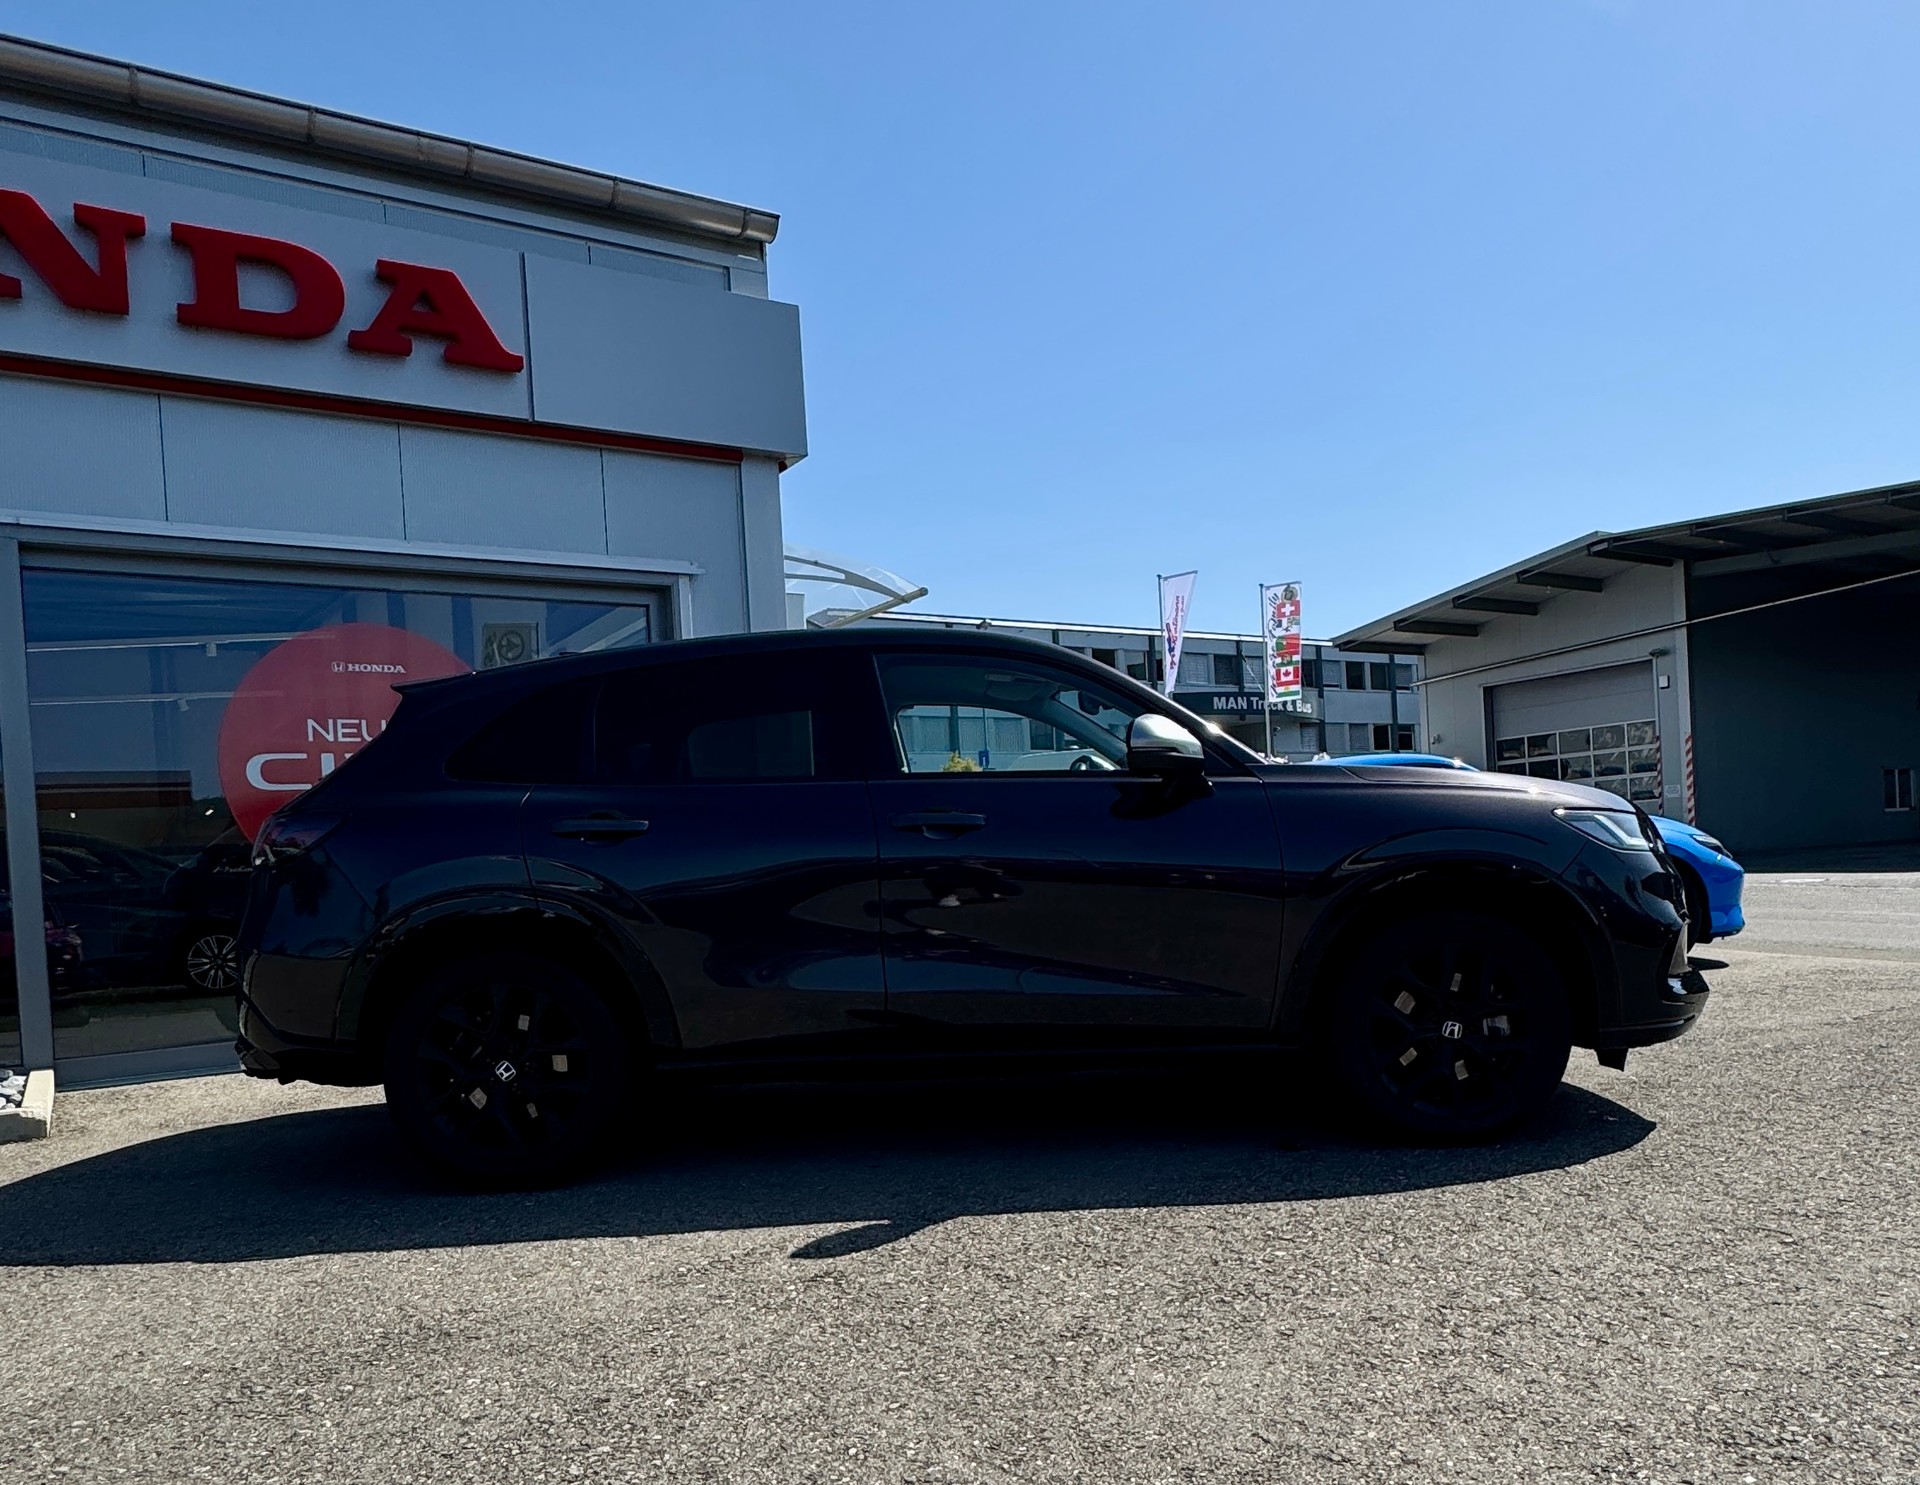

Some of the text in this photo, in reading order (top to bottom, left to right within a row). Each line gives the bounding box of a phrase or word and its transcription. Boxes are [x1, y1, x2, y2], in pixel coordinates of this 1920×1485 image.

[347, 663, 407, 674] HONDA
[1213, 697, 1247, 710] MAN
[1286, 700, 1294, 712] &
[1296, 700, 1312, 713] Bus
[307, 718, 389, 743] NEU
[245, 752, 353, 791] CI
